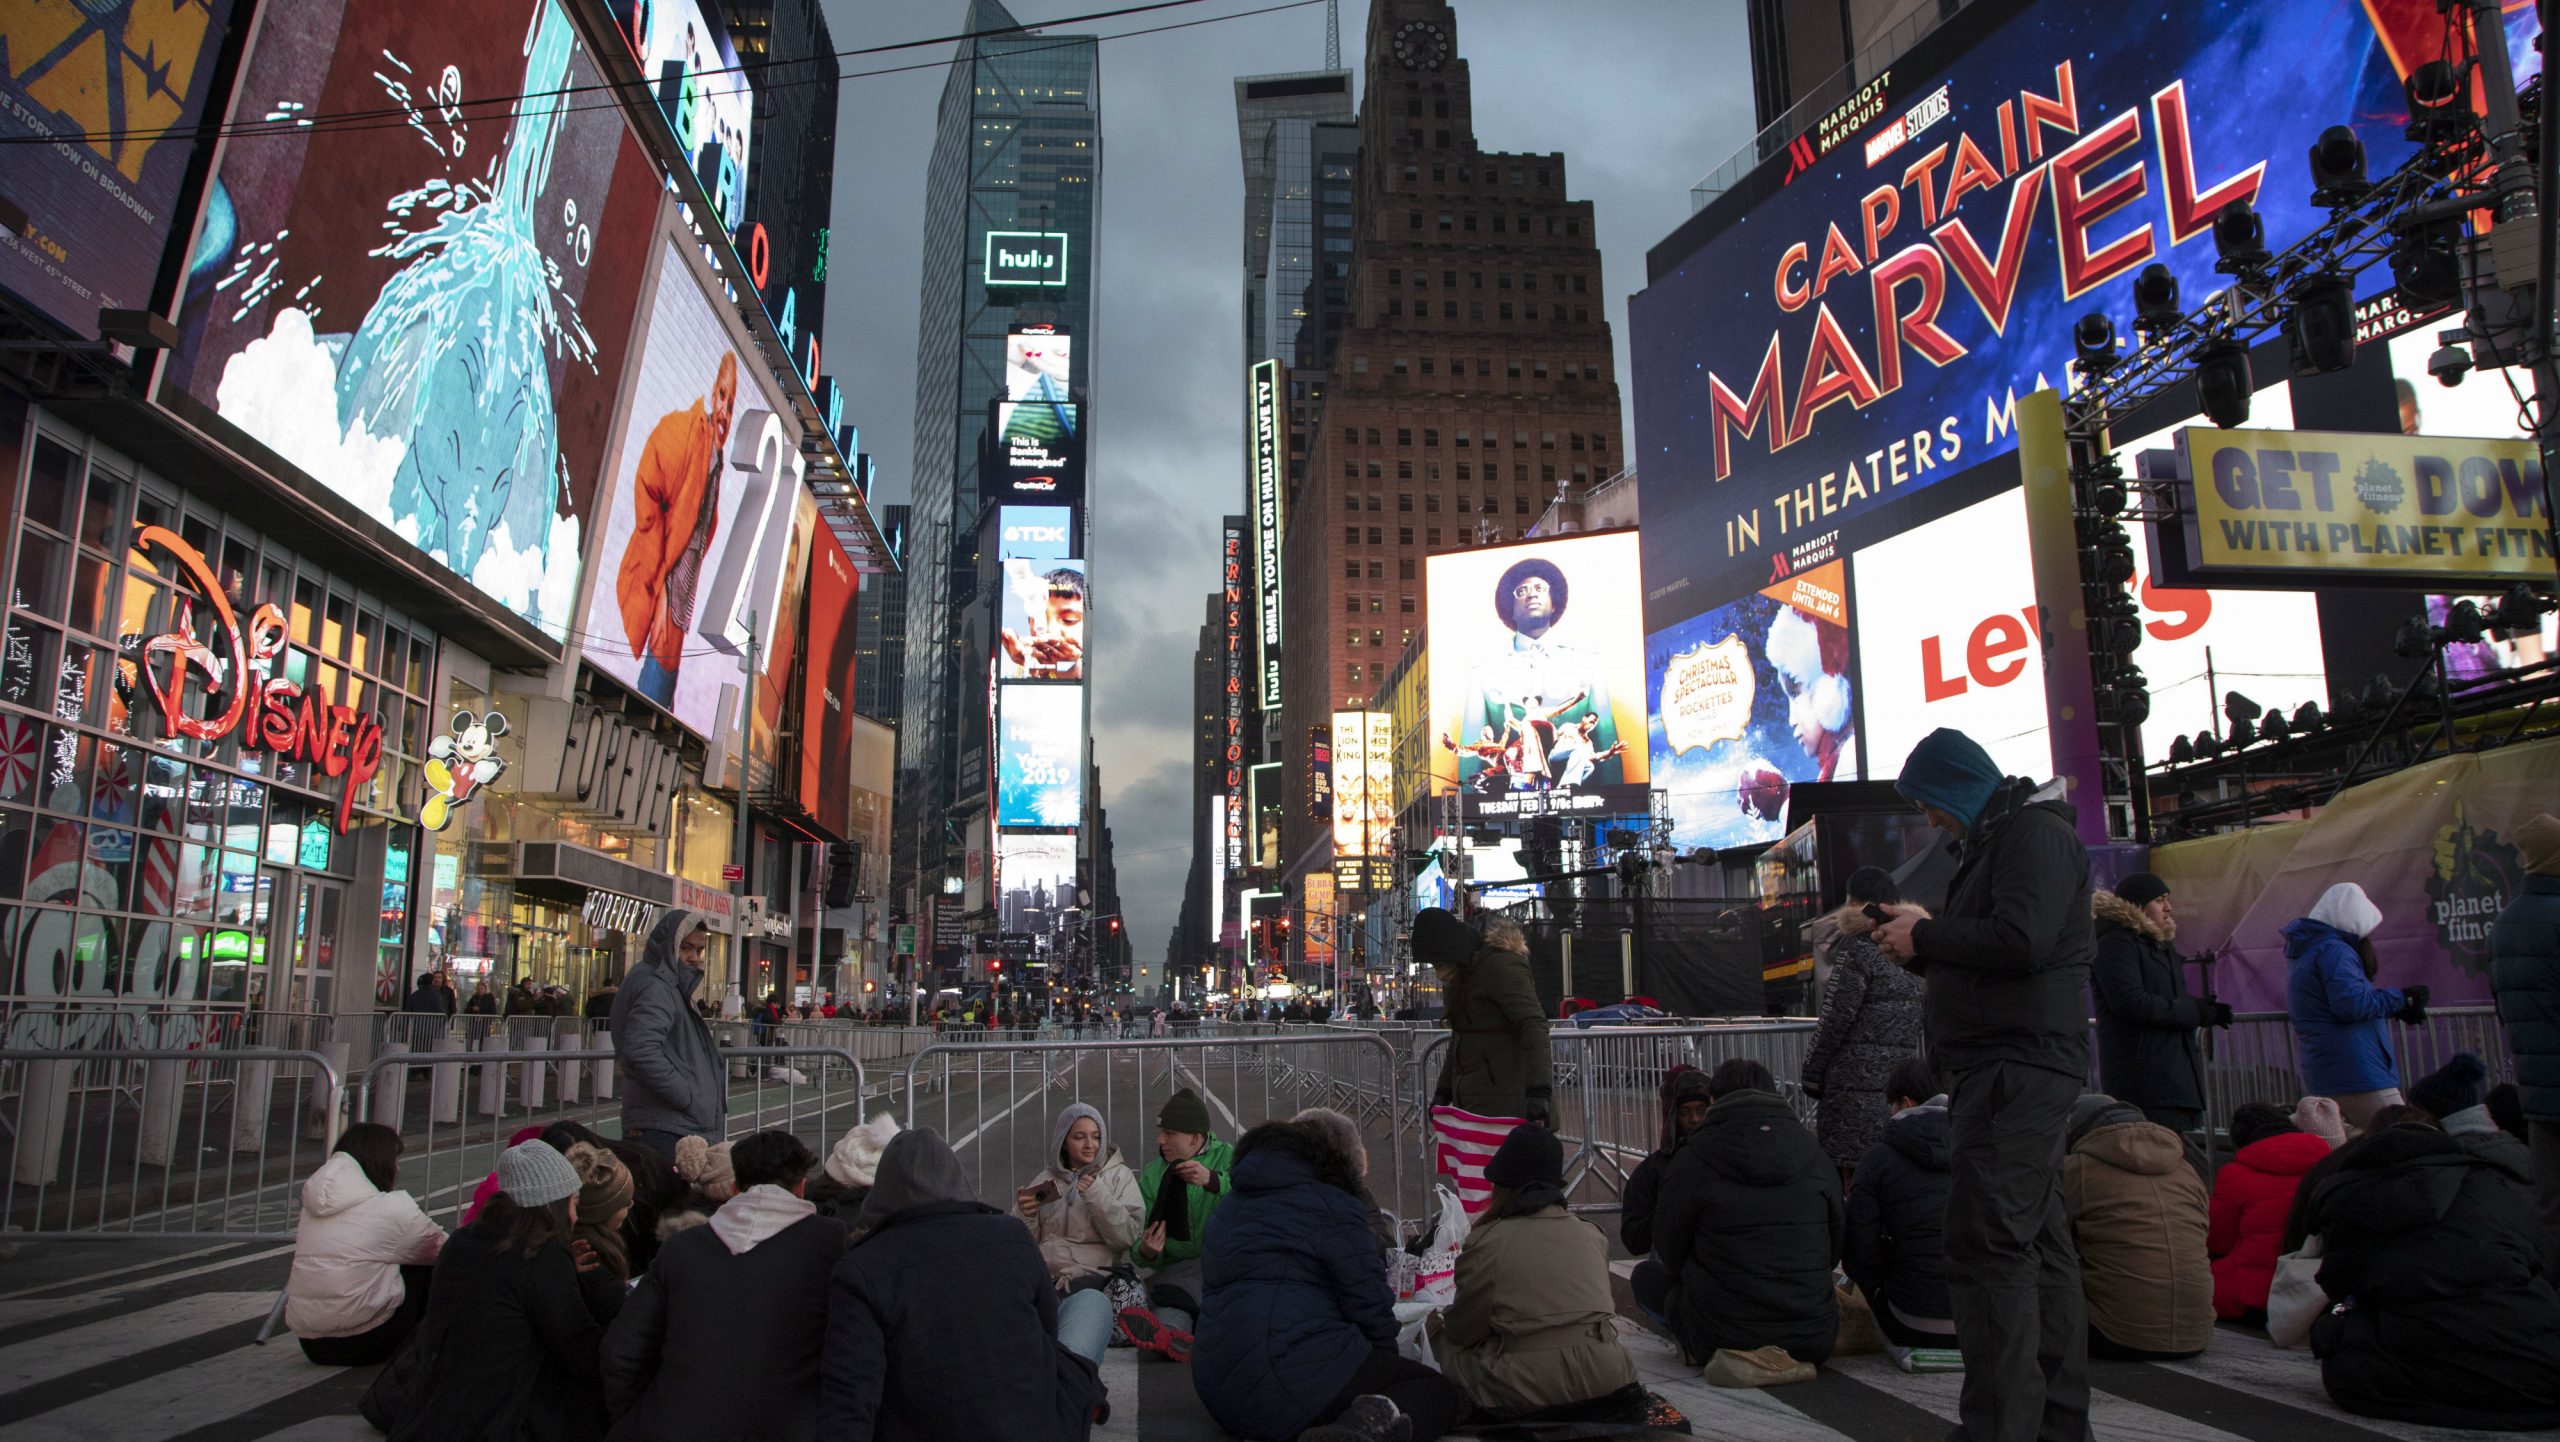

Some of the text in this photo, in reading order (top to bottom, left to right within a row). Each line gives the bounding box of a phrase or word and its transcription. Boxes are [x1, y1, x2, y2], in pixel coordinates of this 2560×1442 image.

[1819, 71, 1890, 135] MARRIOTT
[1820, 96, 1884, 154] MARQUIS
[1866, 88, 1950, 165] MARVEL STUDIOS
[13, 104, 53, 142] STORY
[82, 161, 99, 181] ON
[99, 174, 155, 226] BROADWAY
[1774, 58, 2080, 312] CAPTAIN
[20, 244, 45, 268] WEST
[62, 275, 92, 300] STREET
[999, 248, 1054, 268] hulu
[1709, 79, 2267, 483] MARVEL
[1259, 381, 1271, 405] TV
[1260, 404, 1272, 441] LIVE
[1010, 436, 1040, 447] This is
[1010, 446, 1048, 458] Banking
[1261, 457, 1273, 501] HULU
[1726, 507, 1762, 558] IN
[1774, 416, 1962, 535] THEATERS
[2212, 447, 2549, 519] GET DOW
[2357, 482, 2393, 495] planet
[1262, 500, 1275, 527] ON
[1018, 526, 1066, 542] TDK
[1792, 530, 1840, 558] MARRIOTT
[2219, 519, 2556, 559] WITH PLANET FITN
[1263, 529, 1276, 590] YOU'RE
[1792, 545, 1836, 570] MARQUIS
[1226, 539, 1241, 653] ERNST
[1666, 577, 1691, 595] MARVEL
[1795, 579, 1841, 606] EXTENDED
[1265, 590, 1279, 645] SMILE,
[1791, 590, 1840, 618] UNTIL JAN 6
[1920, 568, 2212, 704] Le's
[1227, 676, 1241, 693] &
[1267, 660, 1280, 701] hulu
[1679, 655, 1731, 686] CHRISTMAS
[1673, 671, 1738, 704] SPECTACULAR
[1679, 691, 1733, 718] ROCKETTES
[1338, 737, 1358, 748] LION
[1336, 750, 1361, 764] KING
[1022, 767, 1070, 784] 2019
[1479, 800, 1519, 814] TUESDAY
[1306, 878, 1333, 888] BUBBA
[1308, 890, 1332, 900] GUMP
[584, 890, 654, 935] FOREVER 21
[695, 888, 713, 910] POLO
[2434, 889, 2504, 926] planet
[2447, 918, 2495, 942] fitne
